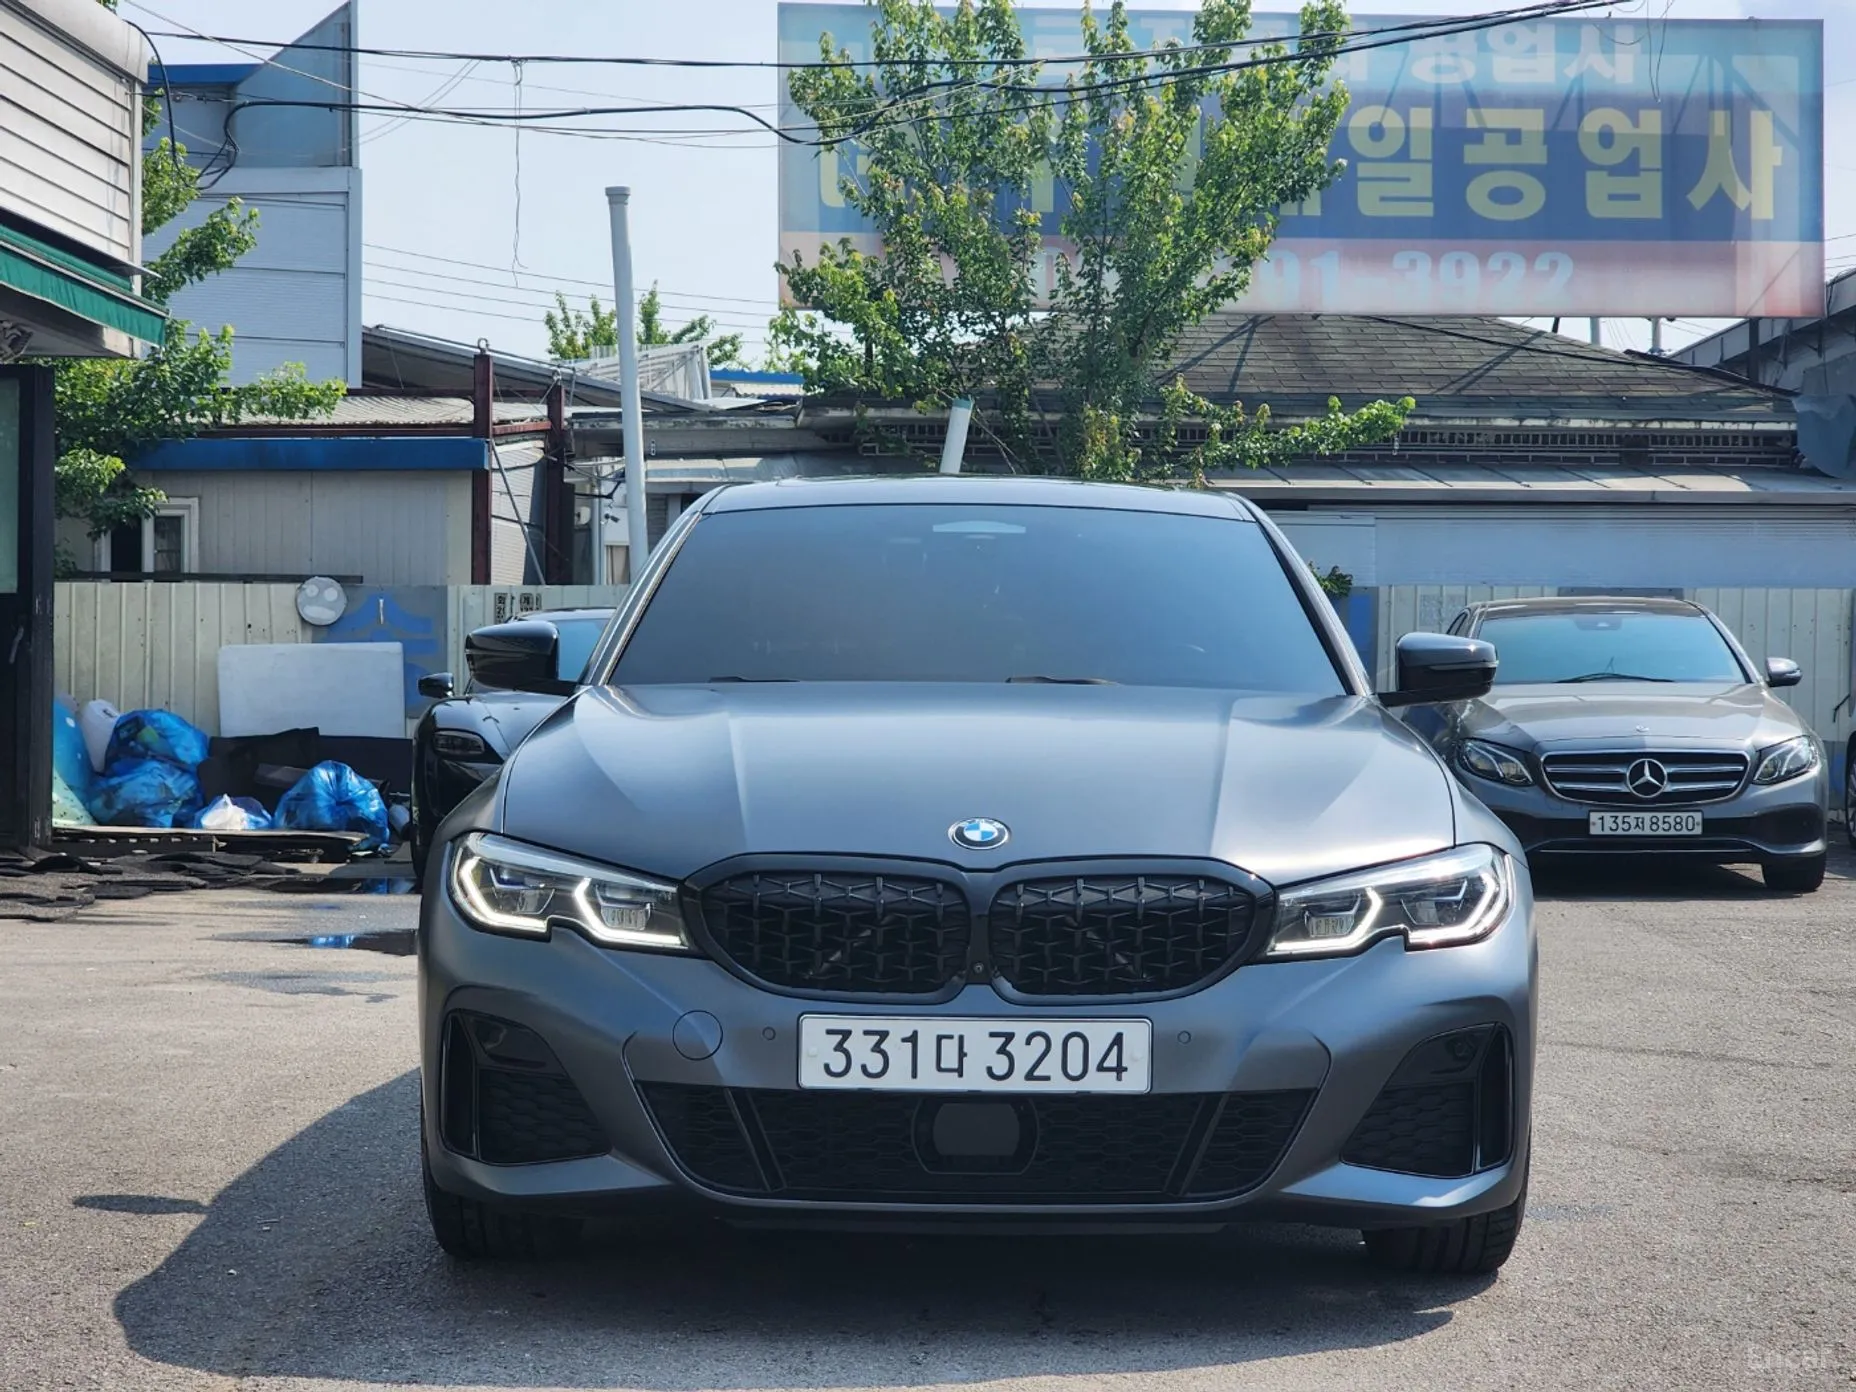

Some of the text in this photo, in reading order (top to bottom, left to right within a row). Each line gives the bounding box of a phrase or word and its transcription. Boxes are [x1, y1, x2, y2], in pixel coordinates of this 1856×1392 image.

[1279, 105, 1783, 221] 일공업사
[1597, 815, 1696, 832] 135저 8580
[822, 1028, 1129, 1082] 331다 3204
